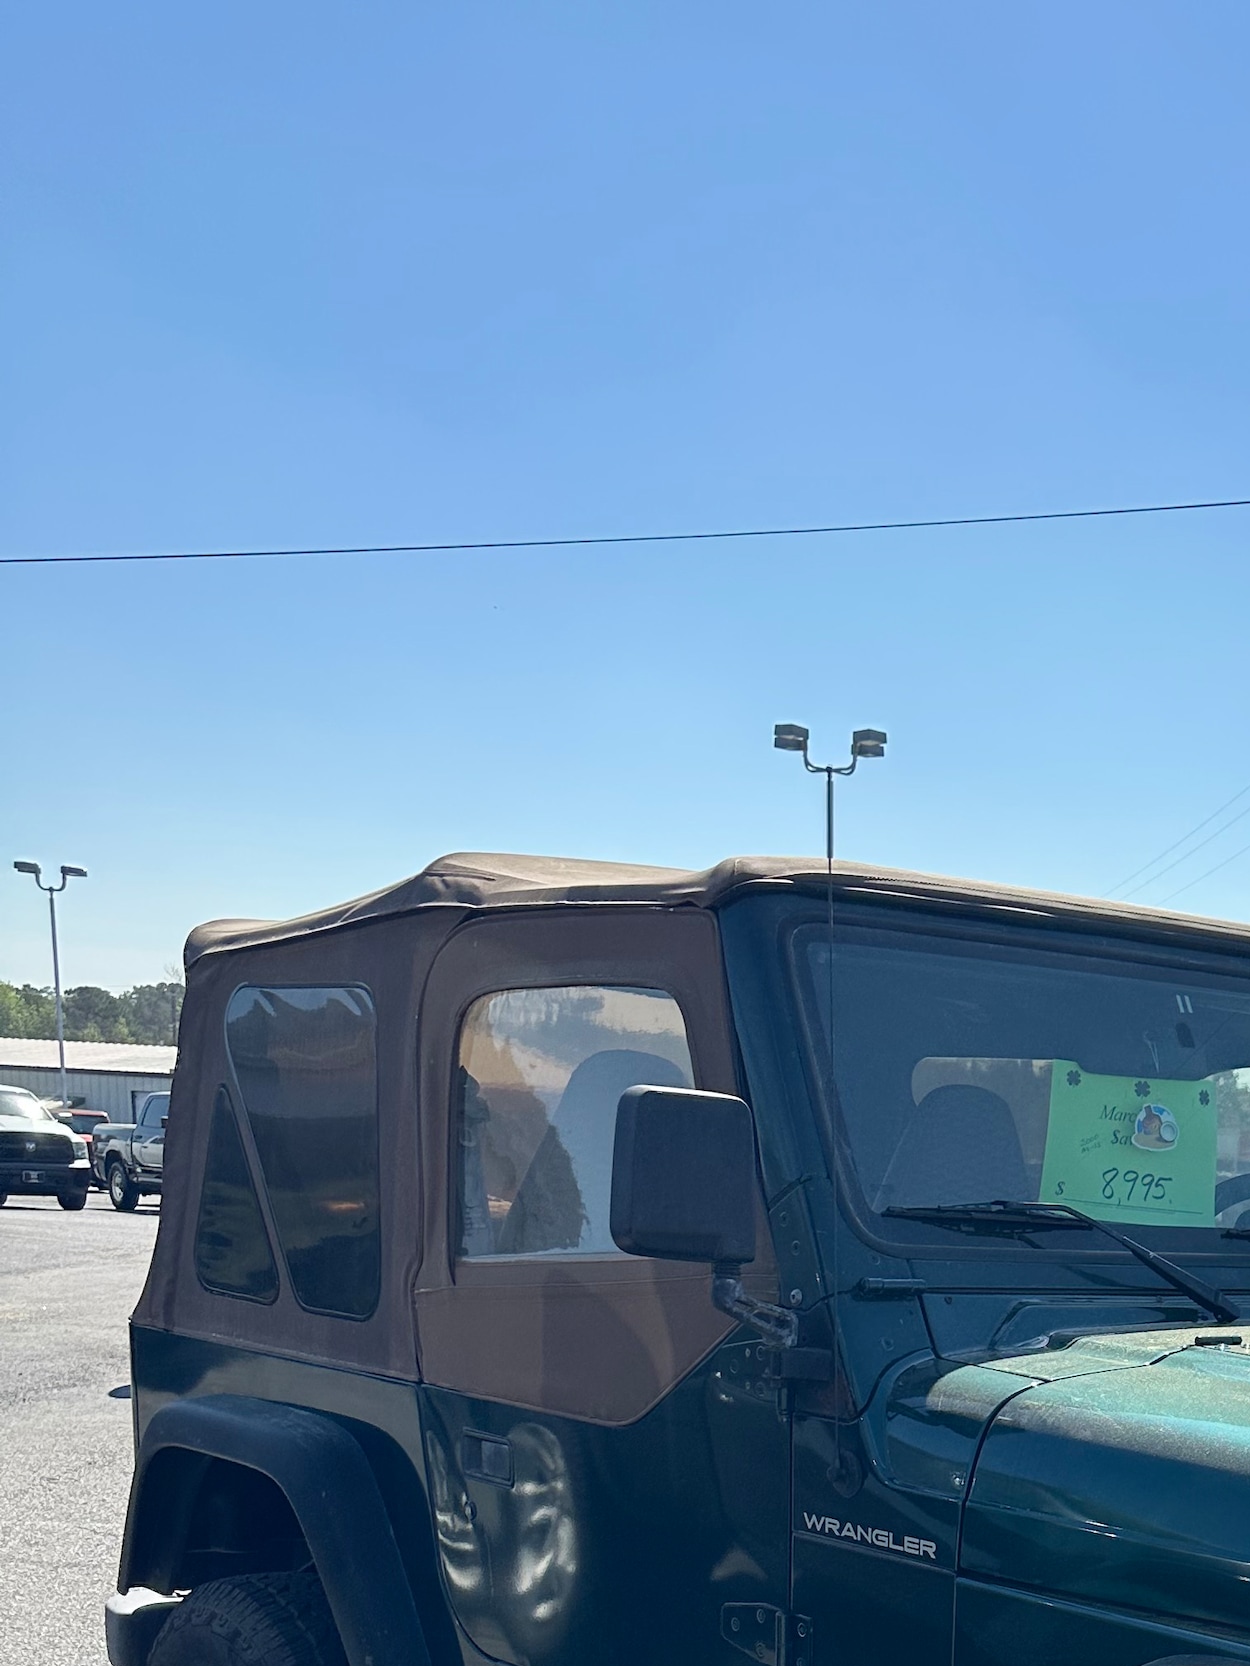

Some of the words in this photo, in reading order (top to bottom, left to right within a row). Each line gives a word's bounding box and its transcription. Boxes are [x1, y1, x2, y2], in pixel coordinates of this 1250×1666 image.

[1099, 1104, 1142, 1124] Marc
[1054, 1181, 1066, 1196] $
[803, 1511, 937, 1560] WRANGLER
